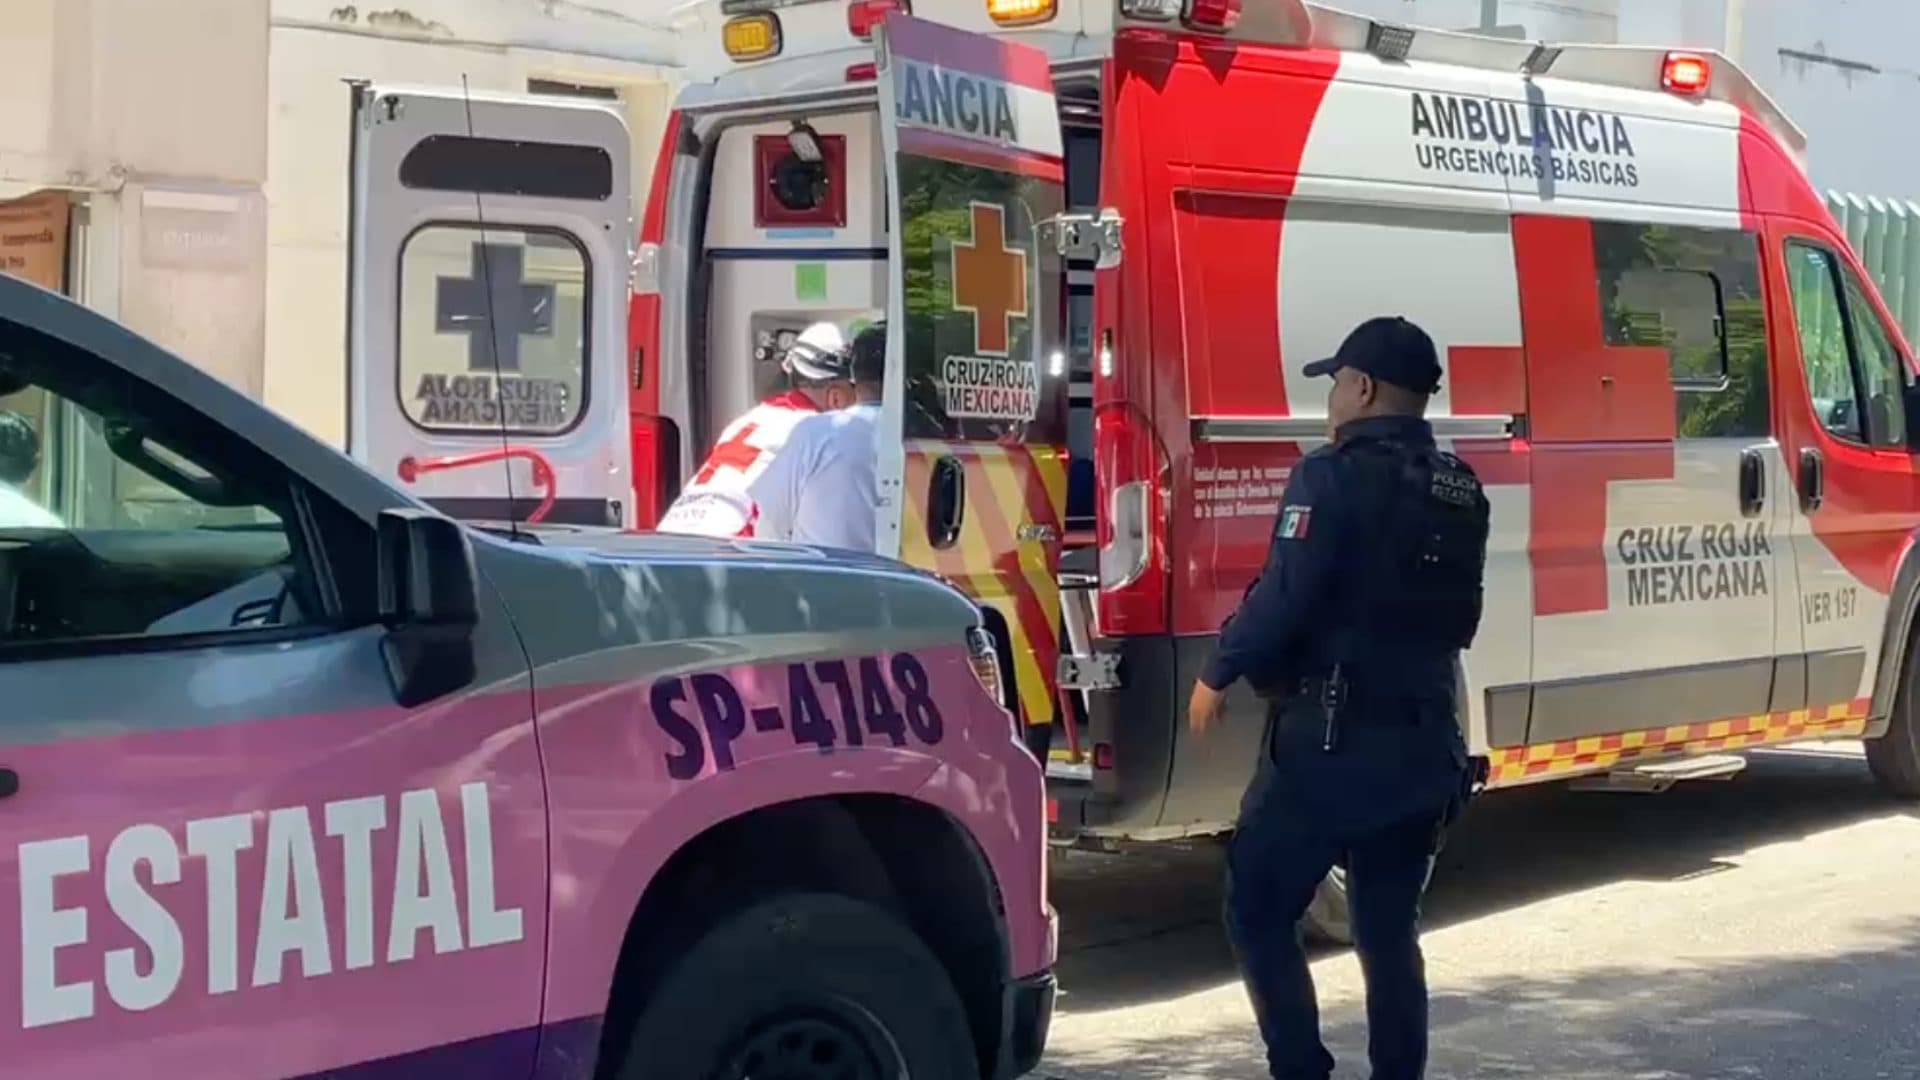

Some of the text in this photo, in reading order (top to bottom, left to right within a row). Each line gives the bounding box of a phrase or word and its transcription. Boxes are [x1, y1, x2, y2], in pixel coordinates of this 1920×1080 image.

[896, 63, 1018, 142] ANCIA
[1411, 92, 1635, 157] AMBULANCIA
[1415, 143, 1638, 187] URGENCIAS BÁSICAS
[945, 360, 1036, 391] CRUZ ROJA
[949, 387, 1033, 417] MEXICANA
[1617, 521, 1771, 565] CRUZ ROJA
[1627, 560, 1768, 607] MEXICANA
[1804, 586, 1857, 624] VER 197
[650, 652, 944, 780] SP-4748
[18, 782, 524, 1029] ESTATAL
